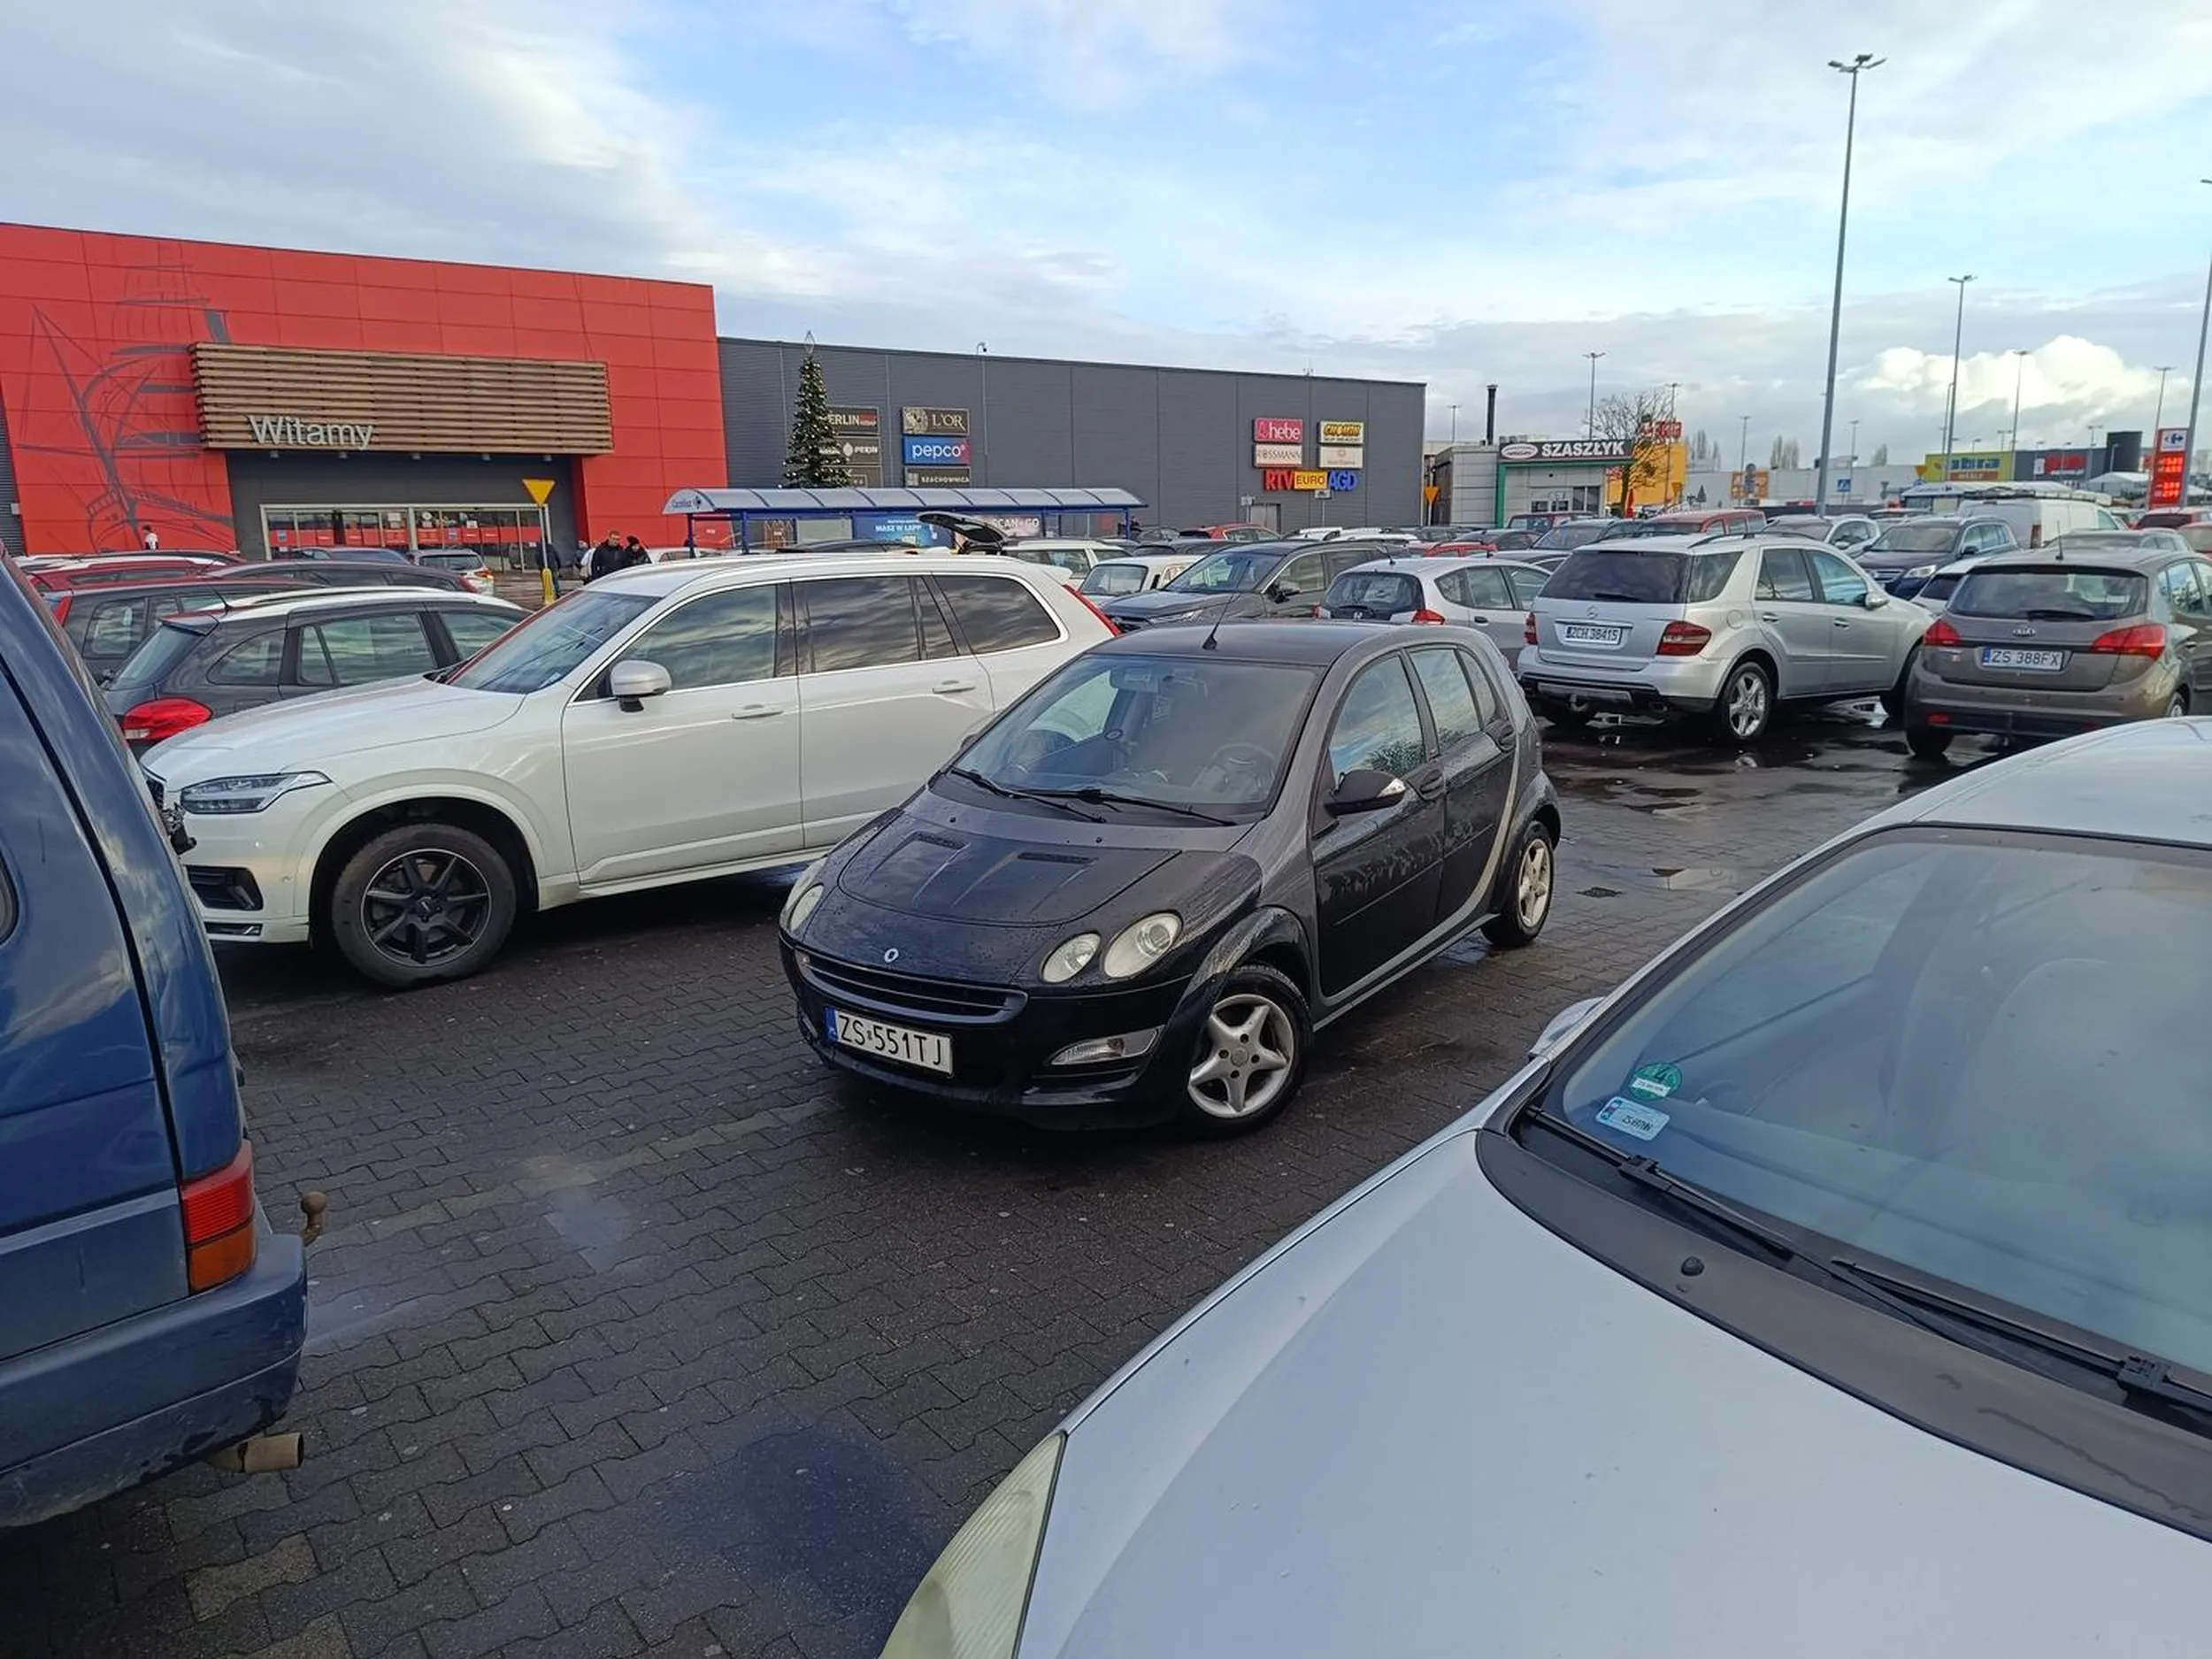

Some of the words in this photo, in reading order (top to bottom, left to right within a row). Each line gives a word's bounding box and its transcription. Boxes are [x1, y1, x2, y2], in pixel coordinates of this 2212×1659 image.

[932, 413, 966, 432] L'OR
[1269, 421, 1301, 440] hebe
[248, 415, 373, 450] Witamy
[912, 445, 962, 460] pepco
[1541, 441, 1624, 457] SZASZŁYK
[1265, 470, 1294, 491] RTV
[1296, 475, 1325, 485] EURO
[1328, 469, 1358, 491] AGD
[1992, 650, 2012, 663] ZS
[2016, 652, 2059, 666] 388FX
[839, 1014, 866, 1046] ZS
[872, 1025, 941, 1065] 551TJ
